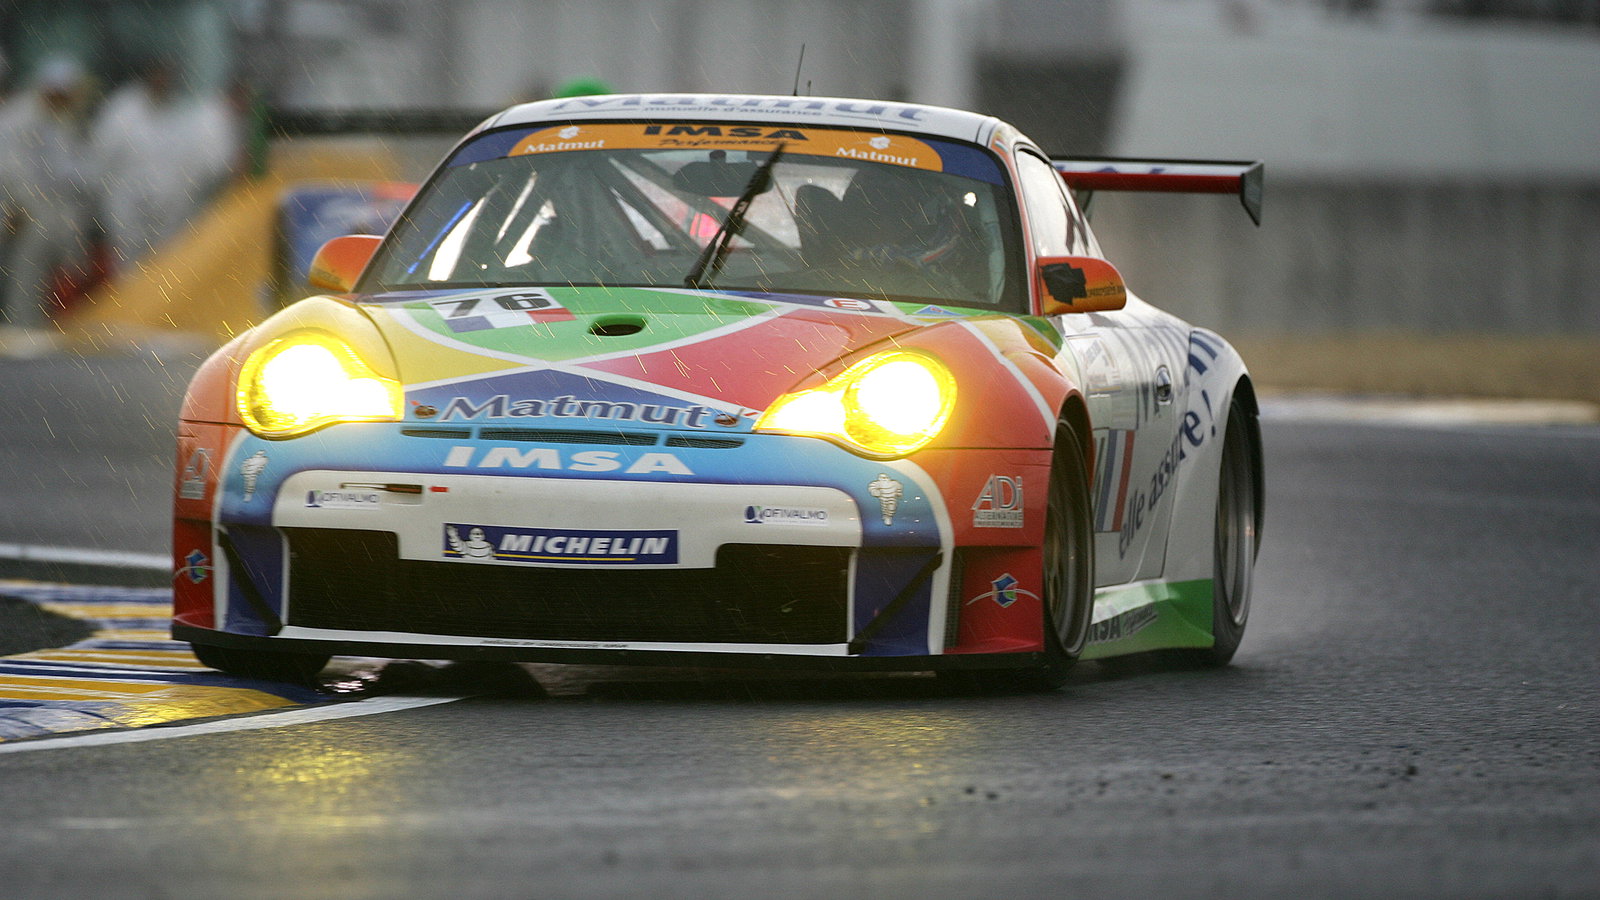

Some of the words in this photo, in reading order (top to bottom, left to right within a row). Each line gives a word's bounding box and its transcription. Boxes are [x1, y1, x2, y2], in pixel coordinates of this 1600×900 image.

[643, 125, 810, 141] IMSA
[523, 140, 605, 153] Matmut
[835, 147, 918, 168] Matmut
[431, 293, 552, 318] 76
[437, 394, 712, 429] Matmut
[443, 446, 697, 476] IMSA
[1118, 489, 1146, 561] elle
[500, 533, 670, 556] MICHELIN
